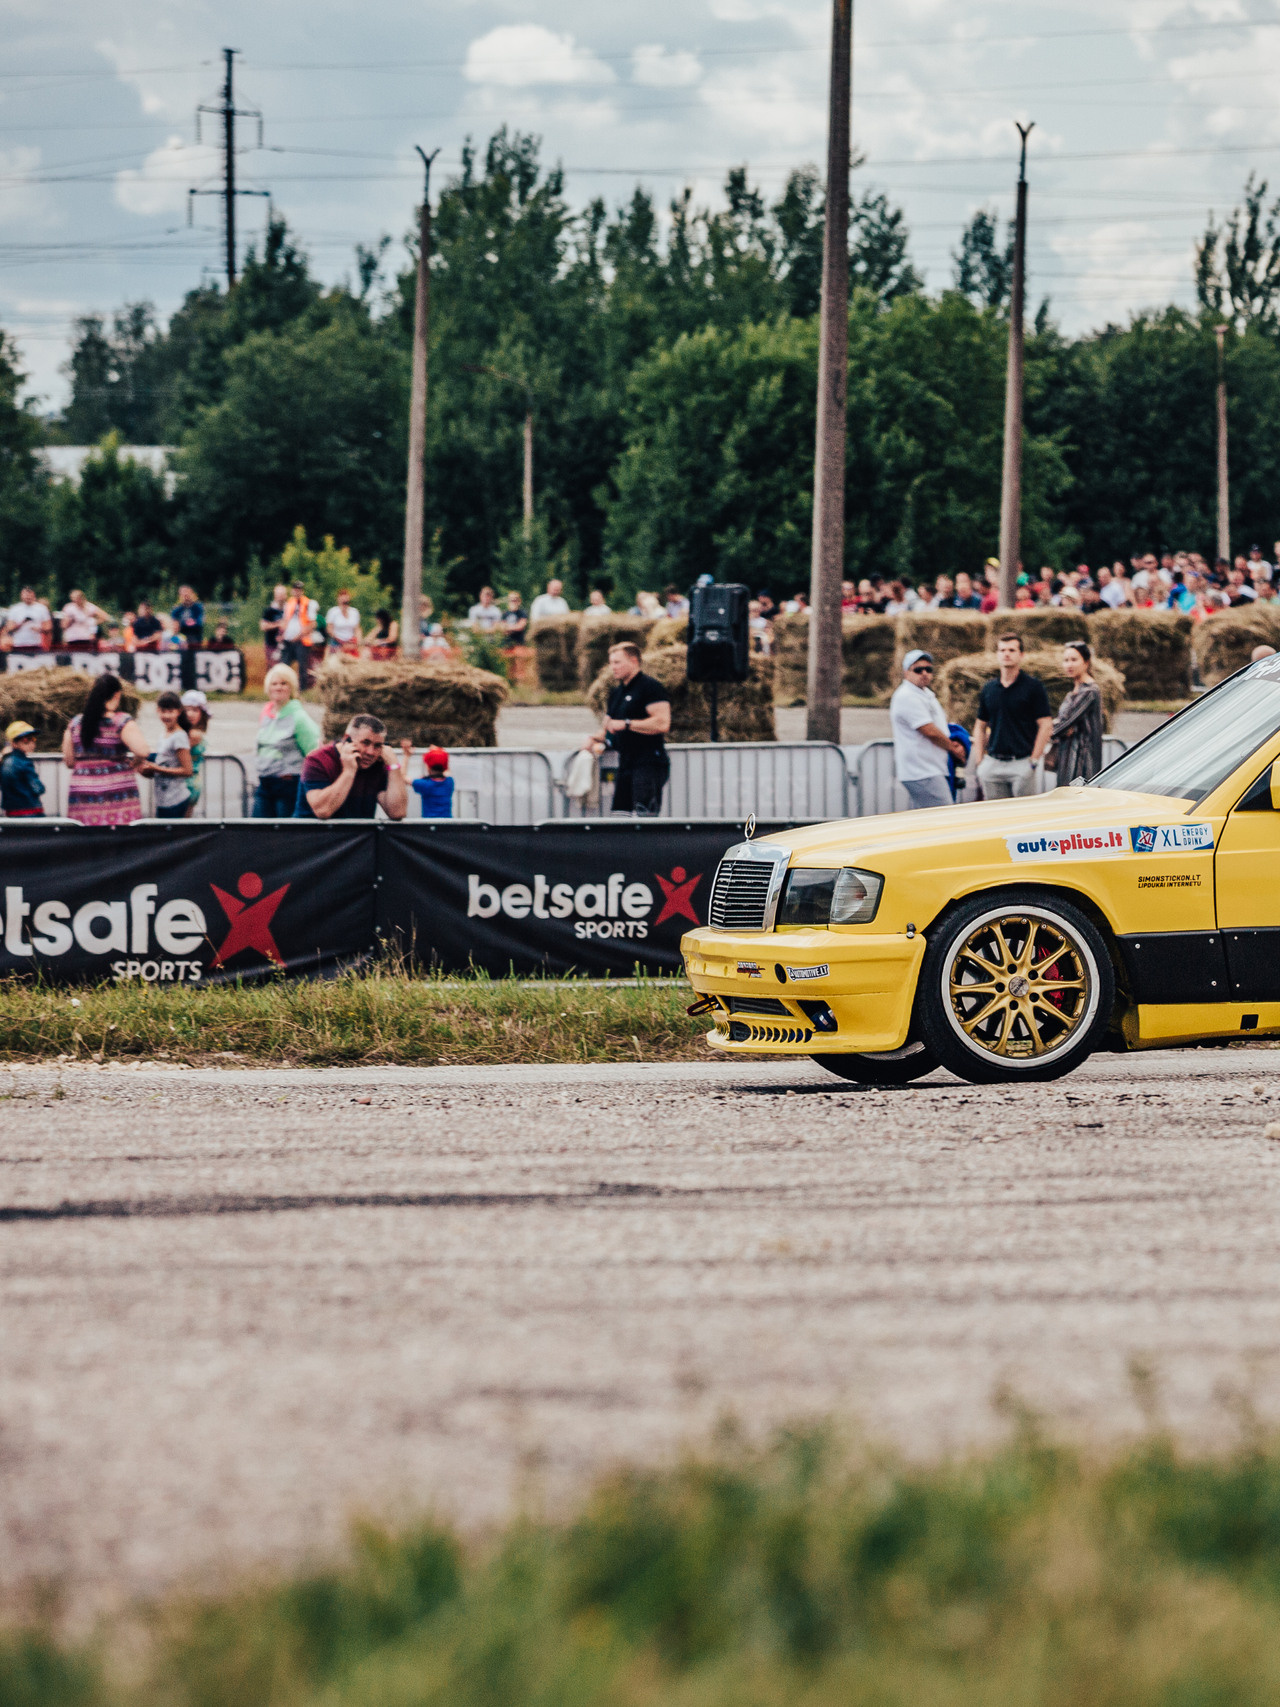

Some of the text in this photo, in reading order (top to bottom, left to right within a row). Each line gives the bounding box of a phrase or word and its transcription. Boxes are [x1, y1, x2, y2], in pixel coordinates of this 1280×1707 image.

[134, 652, 182, 692] DC
[195, 651, 242, 693] DC
[1138, 830, 1154, 846] XL
[1161, 829, 1182, 847] XL
[1182, 827, 1209, 837] ENERGY
[1183, 837, 1203, 846] DRINK
[1138, 874, 1202, 883] SIMONSTICKON.LT
[468, 873, 654, 919] betsafe
[0, 883, 207, 956] tsafe
[574, 920, 649, 939] SPORTS
[112, 960, 203, 982] SPORTS
